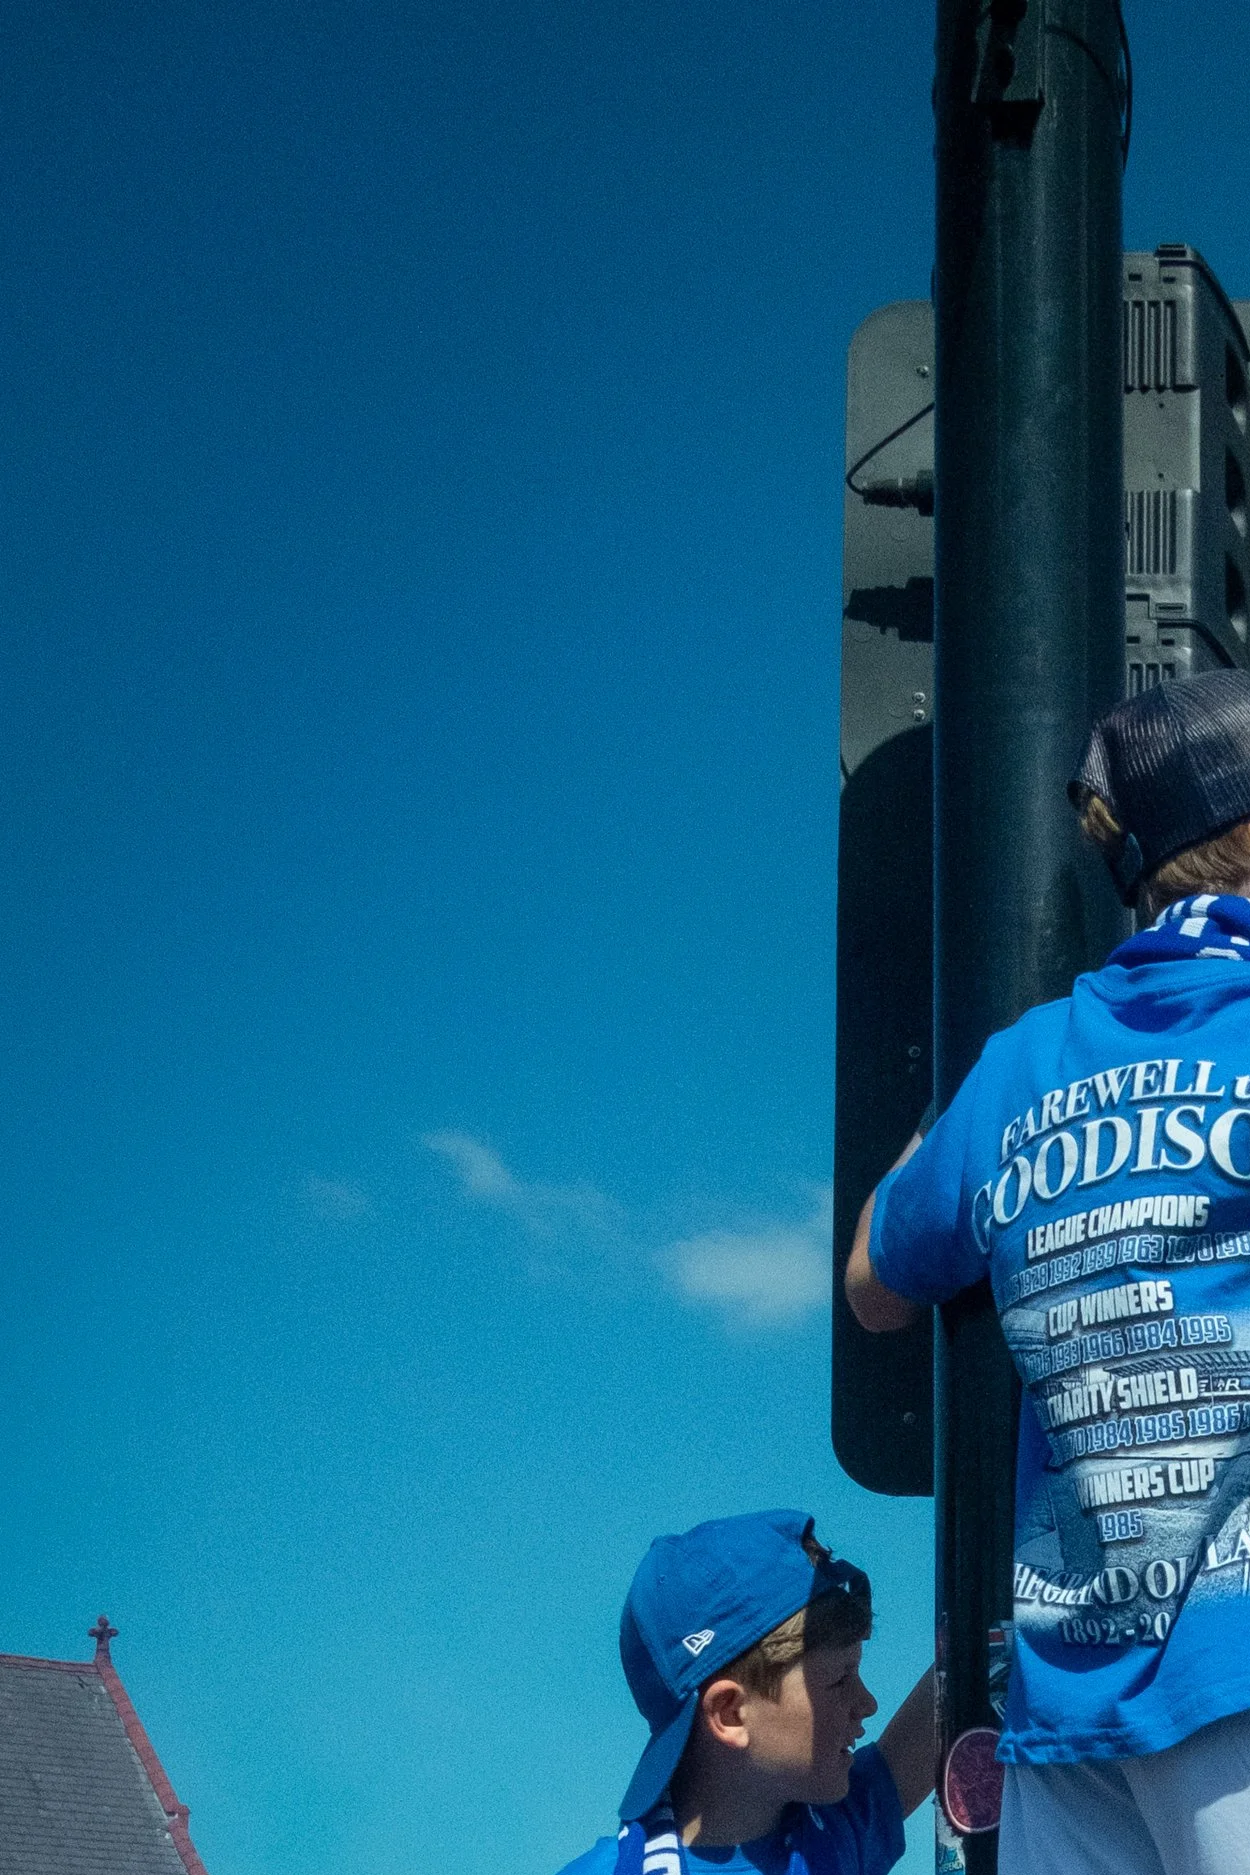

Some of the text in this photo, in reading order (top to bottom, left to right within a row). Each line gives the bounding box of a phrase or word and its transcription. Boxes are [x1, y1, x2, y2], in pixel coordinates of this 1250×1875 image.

[1001, 1058, 1226, 1163] FAREWELL
[1026, 1195, 1211, 1260] LEAGUE CHAMPIONS
[1048, 1251, 1084, 1286] 1932
[1081, 1239, 1118, 1276] 1939
[1116, 1234, 1165, 1264] 1963
[1048, 1279, 1174, 1337] CUP WINNERS
[1050, 1337, 1082, 1375] 1933
[1081, 1328, 1126, 1364] 1966
[1124, 1318, 1178, 1355] 1984
[1179, 1315, 1233, 1347] 1995
[1046, 1367, 1199, 1428] CHARITY SHIELD
[1086, 1418, 1132, 1454] 1984
[1134, 1410, 1186, 1445] 1985
[1187, 1403, 1241, 1438] 1986
[1167, 1458, 1215, 1495] CUP
[1096, 1508, 1144, 1543] 1985
[1061, 1615, 1120, 1646] 1892
[1138, 1611, 1172, 1642] 20
